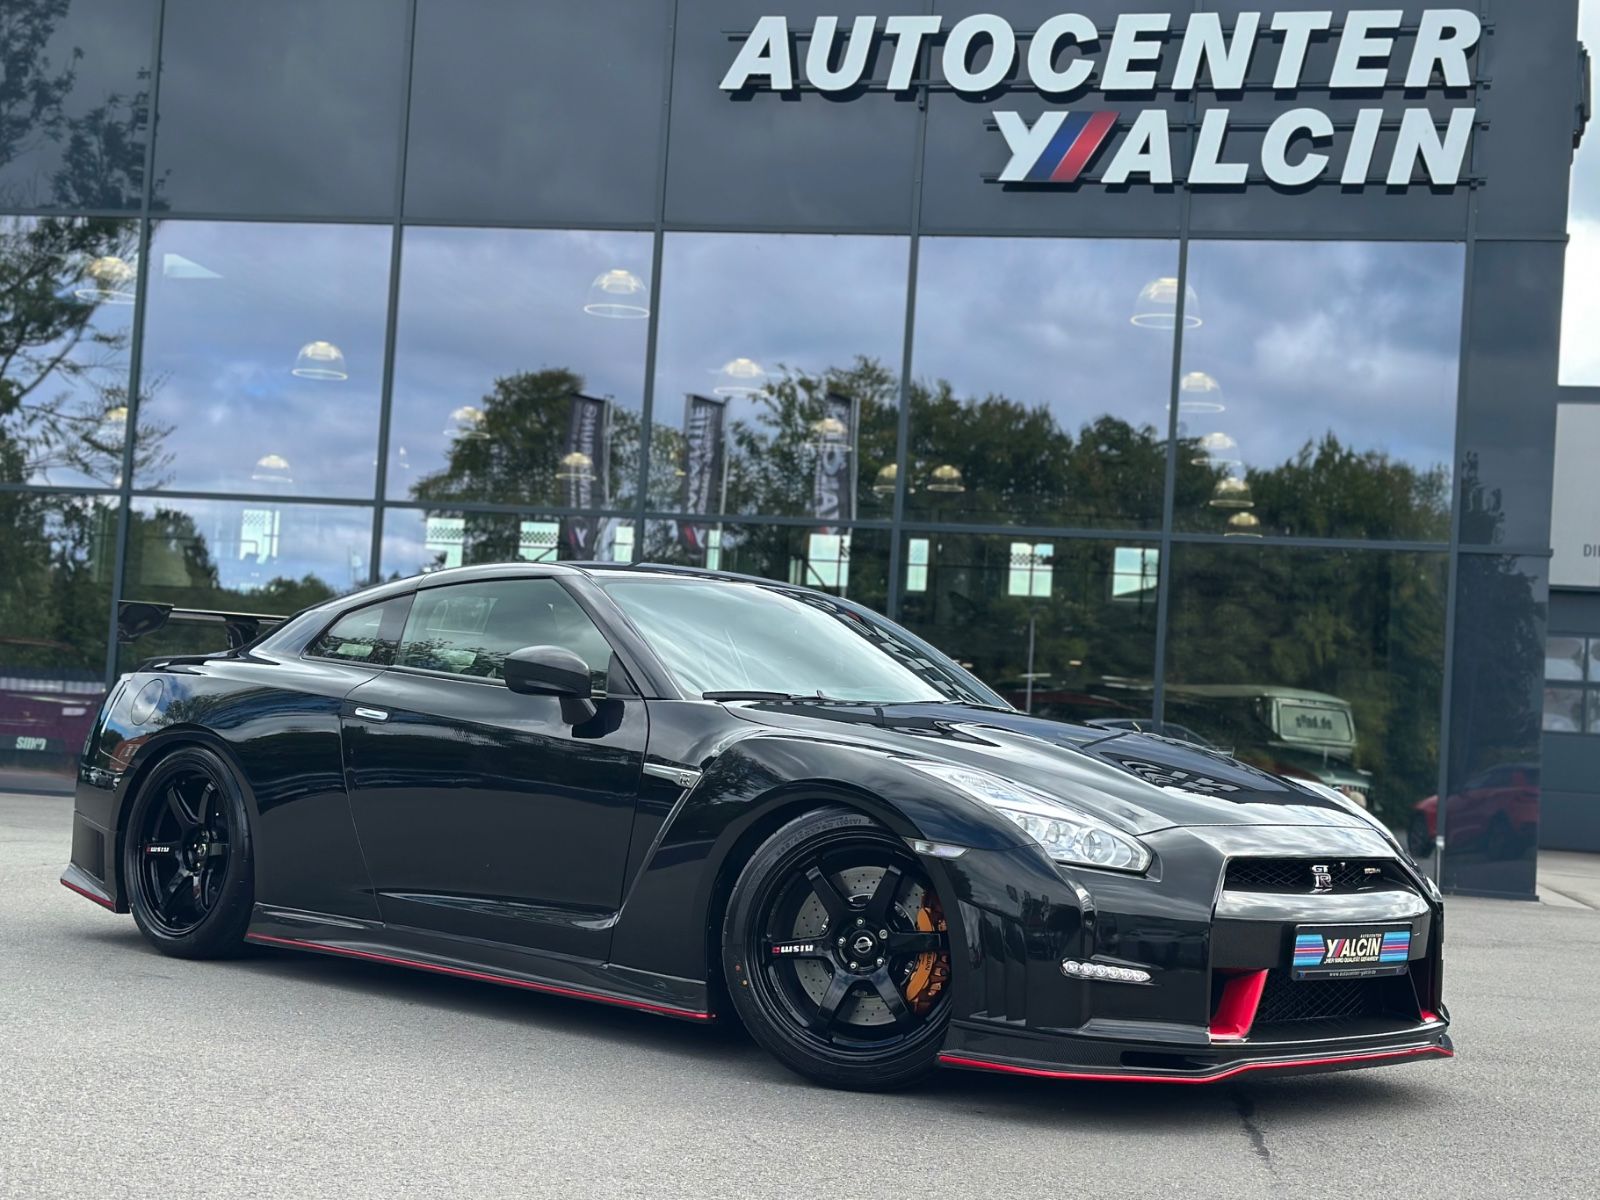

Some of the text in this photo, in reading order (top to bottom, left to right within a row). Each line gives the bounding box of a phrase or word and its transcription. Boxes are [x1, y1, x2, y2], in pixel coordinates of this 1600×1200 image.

[720, 9, 1482, 94] AUTOCENTER
[992, 107, 1477, 187] YALCIN
[1583, 544, 1600, 557] DI
[772, 944, 814, 954] NISMO
[1326, 938, 1382, 957] YALCIN
